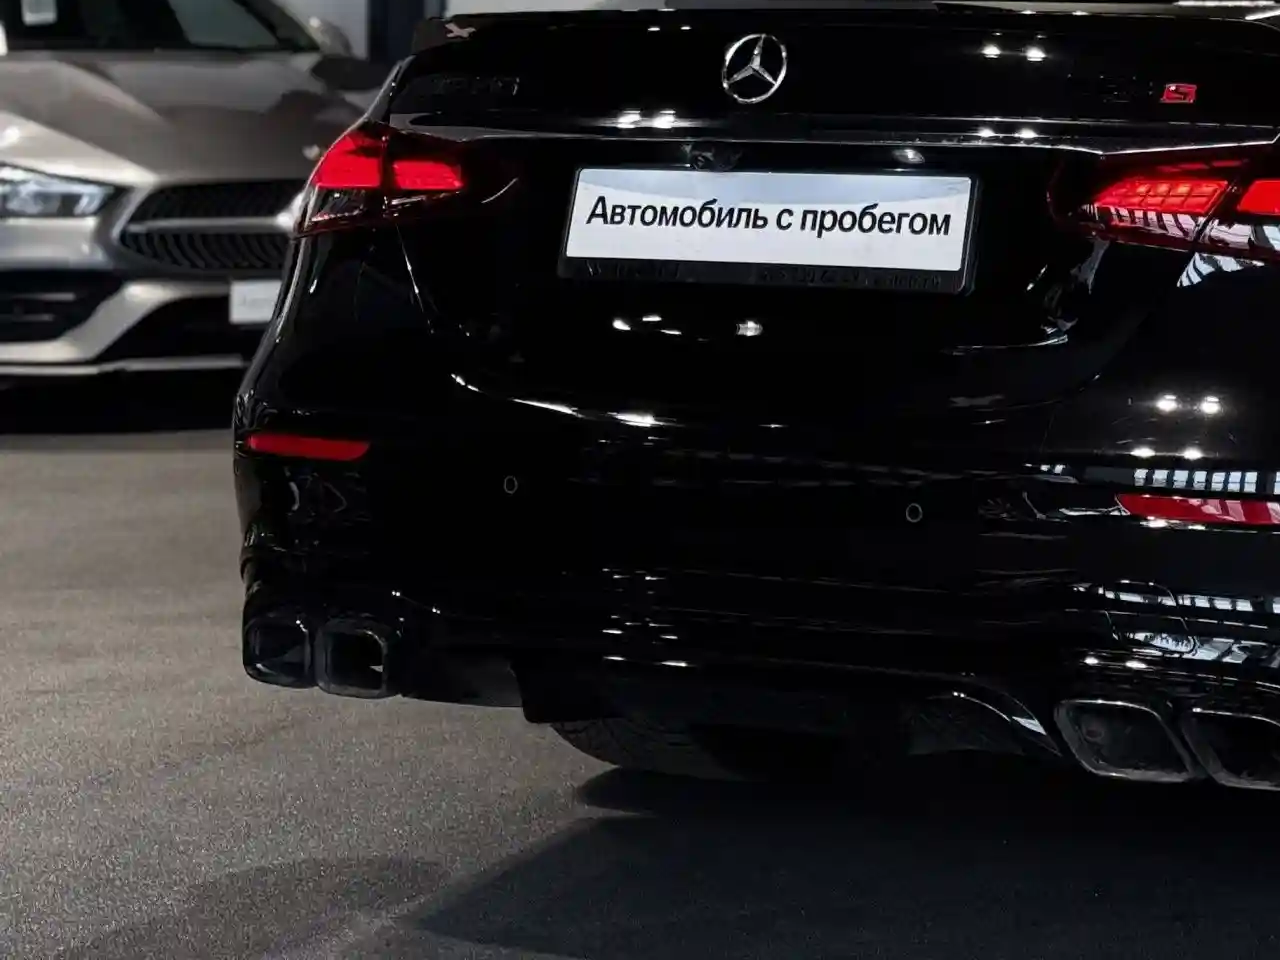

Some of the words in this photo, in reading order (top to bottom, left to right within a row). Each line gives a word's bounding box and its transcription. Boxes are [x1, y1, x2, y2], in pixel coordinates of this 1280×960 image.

[586, 195, 770, 231] Автомобиль
[776, 207, 793, 231] с
[800, 203, 952, 238] пробегом
